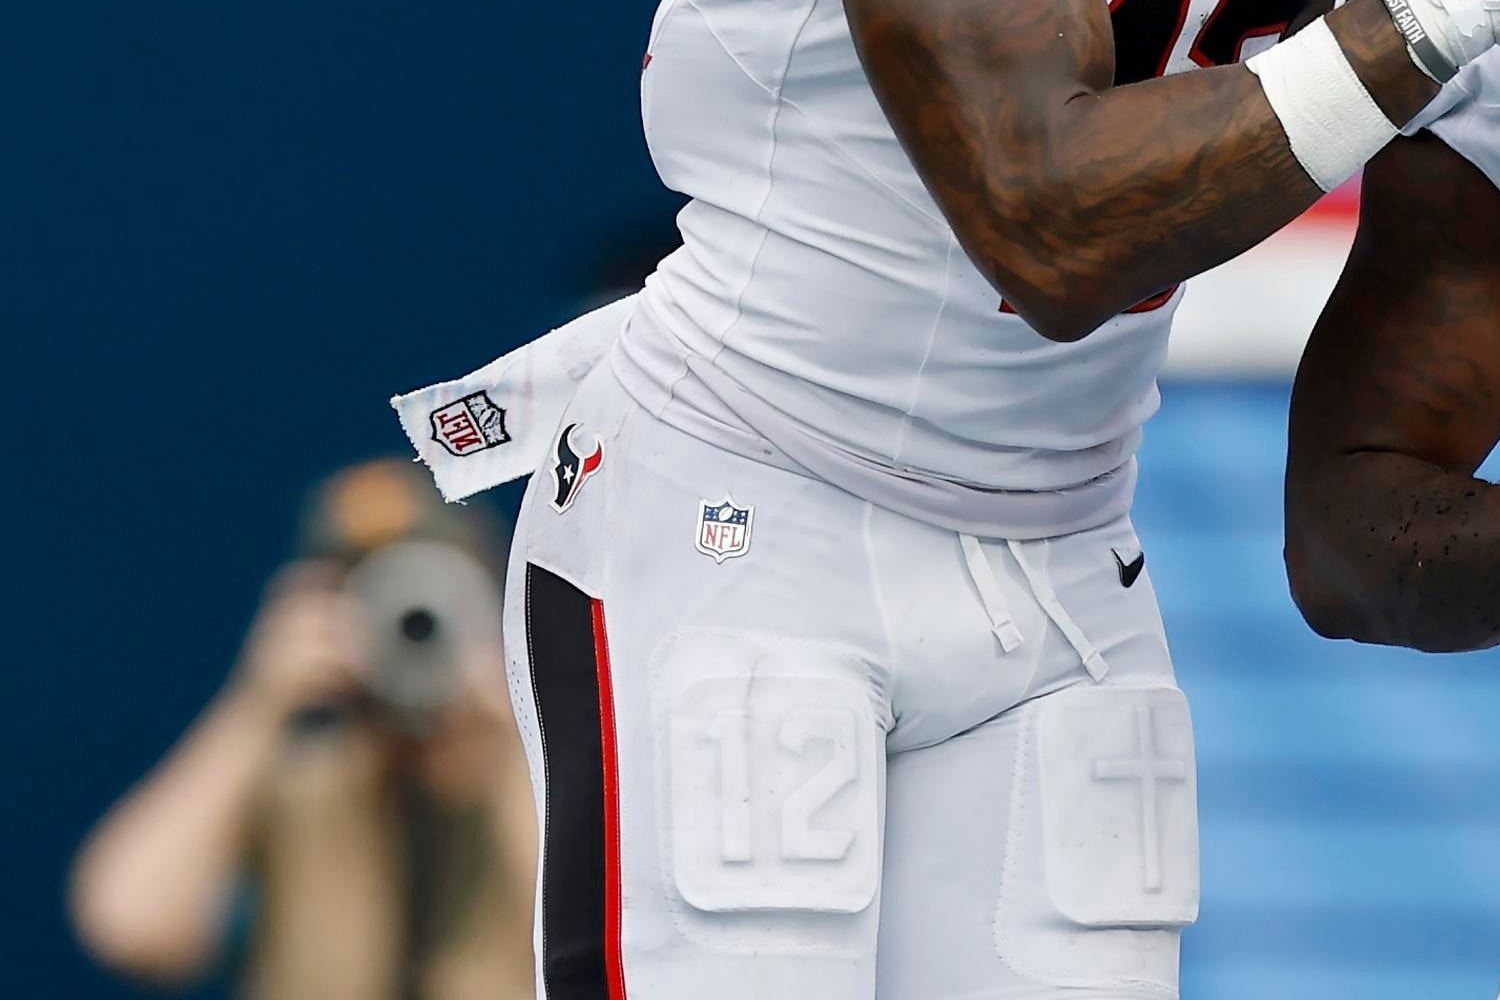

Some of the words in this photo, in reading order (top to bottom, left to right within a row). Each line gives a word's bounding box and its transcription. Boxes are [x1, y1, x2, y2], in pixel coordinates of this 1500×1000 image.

[1396, 8, 1426, 45] FAITH
[436, 410, 483, 452] NFL
[704, 523, 741, 550] NFL
[697, 708, 857, 866] 12
